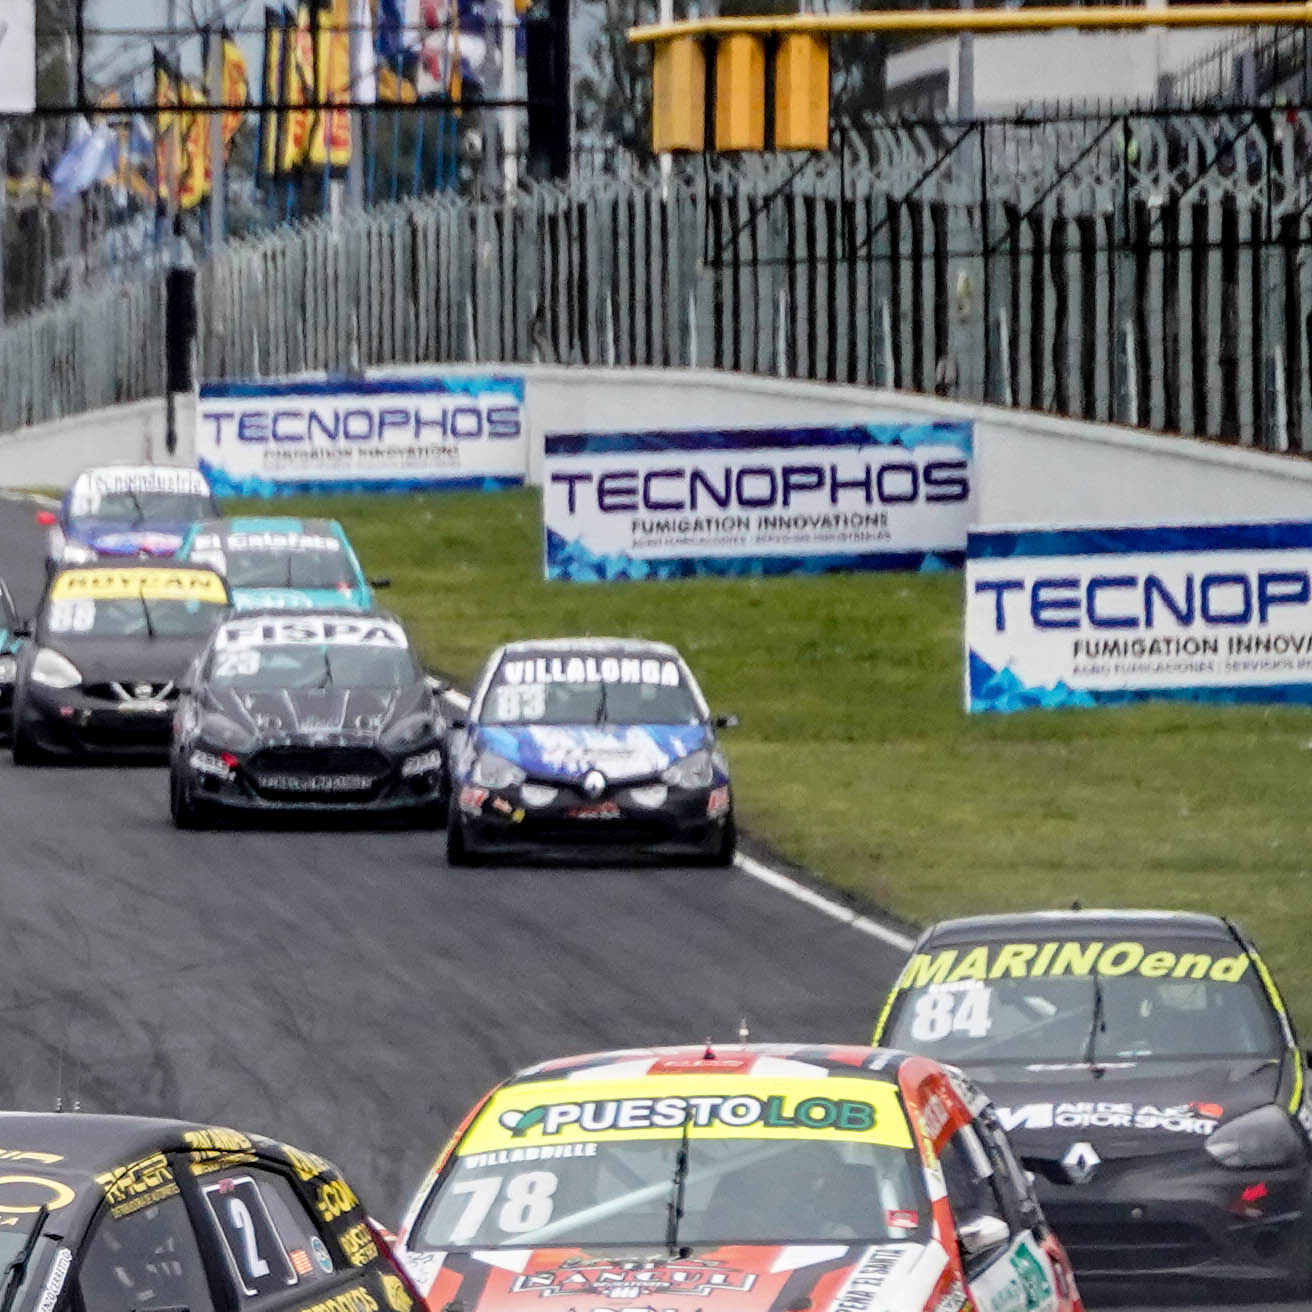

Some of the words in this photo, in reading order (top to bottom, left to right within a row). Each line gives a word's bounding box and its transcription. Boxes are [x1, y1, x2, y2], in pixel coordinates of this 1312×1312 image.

[202, 406, 522, 446] TECNOPHOS
[550, 460, 971, 515] TECNOPHOS
[631, 516, 751, 535] FUMIGATION
[757, 512, 889, 531] INNOVATIONS
[974, 571, 1312, 632] TECNOP
[1072, 636, 1219, 659] FUMIGATION
[901, 941, 1251, 991] MARINOend
[911, 984, 993, 1042] 84
[448, 1169, 558, 1246] 78
[228, 1197, 271, 1279] 2
